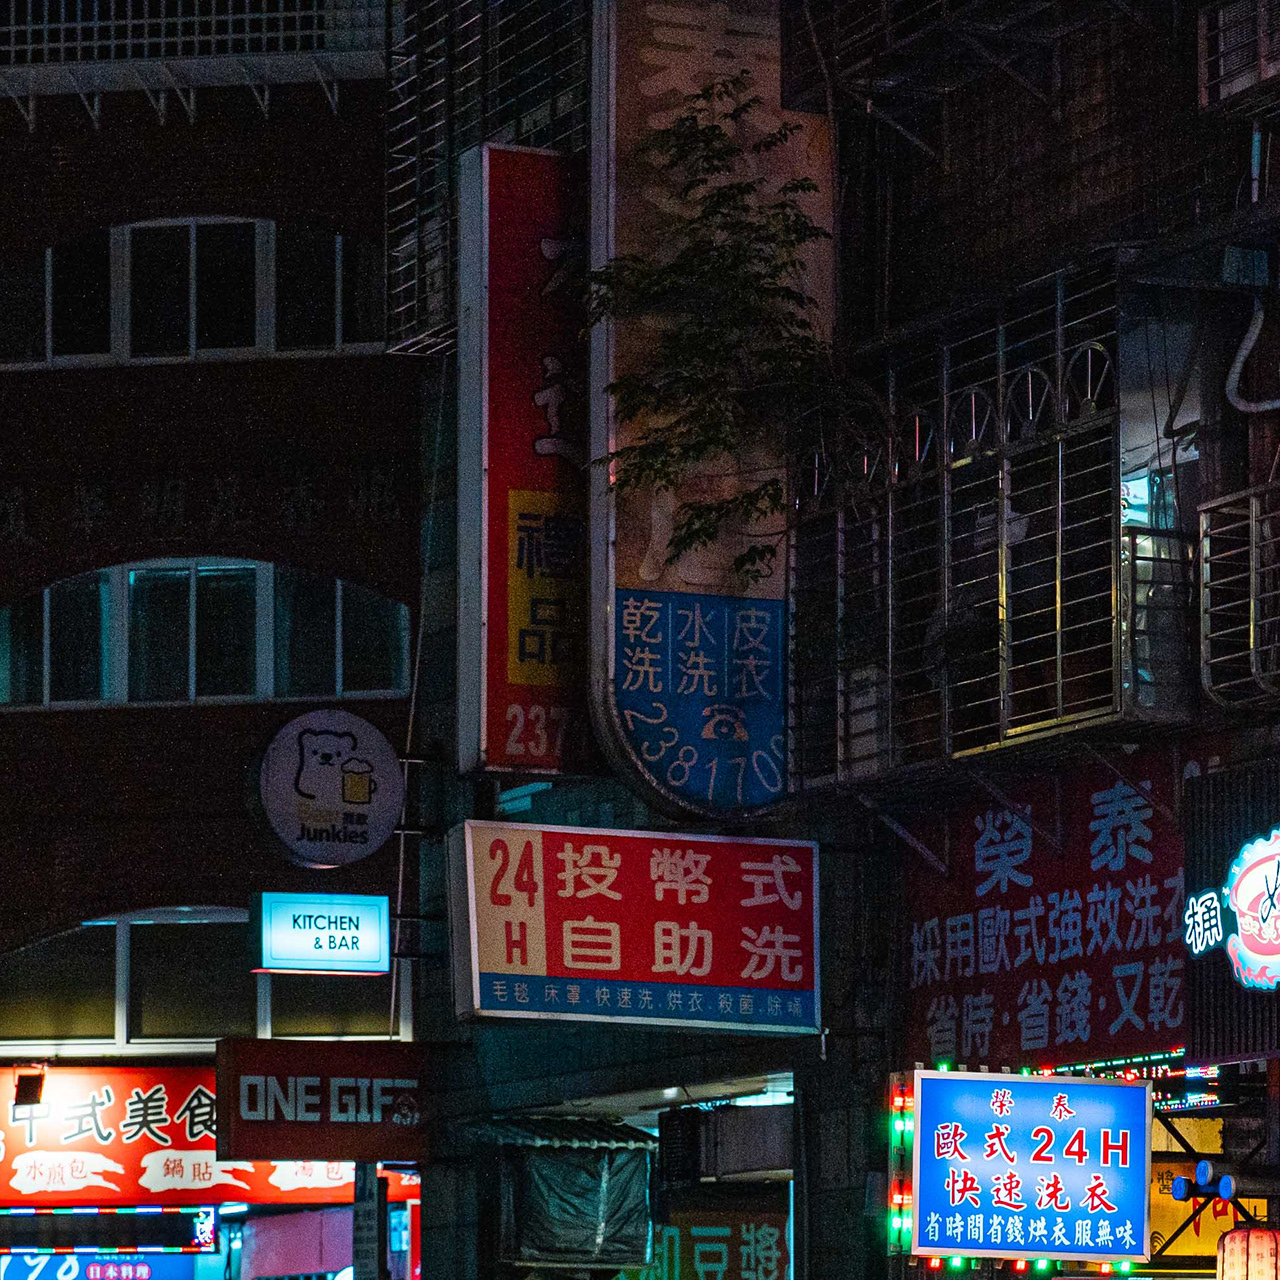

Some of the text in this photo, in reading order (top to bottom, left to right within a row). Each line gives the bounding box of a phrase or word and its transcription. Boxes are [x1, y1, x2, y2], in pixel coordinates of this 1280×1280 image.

[622, 597, 664, 694] 乾洗
[676, 601, 718, 698] 水洗
[295, 823, 369, 845] Junkies
[974, 780, 1153, 897] 榮泰
[489, 838, 538, 908] 24
[556, 841, 803, 911] 投幣式
[292, 914, 360, 931] KITCHEN
[313, 936, 360, 951] & BAR
[504, 919, 528, 966] H
[562, 914, 804, 982] 自助洗
[239, 1075, 321, 1123] ONE
[990, 1089, 1076, 1122] 榮泰
[25, 1158, 88, 1187] 水煎包
[162, 1157, 213, 1183] 鍋貼
[944, 1168, 1118, 1214] 快速洗衣
[924, 1211, 1137, 1250] 省時間省錢烘衣服無味
[86, 1262, 152, 1280] 日本料理
